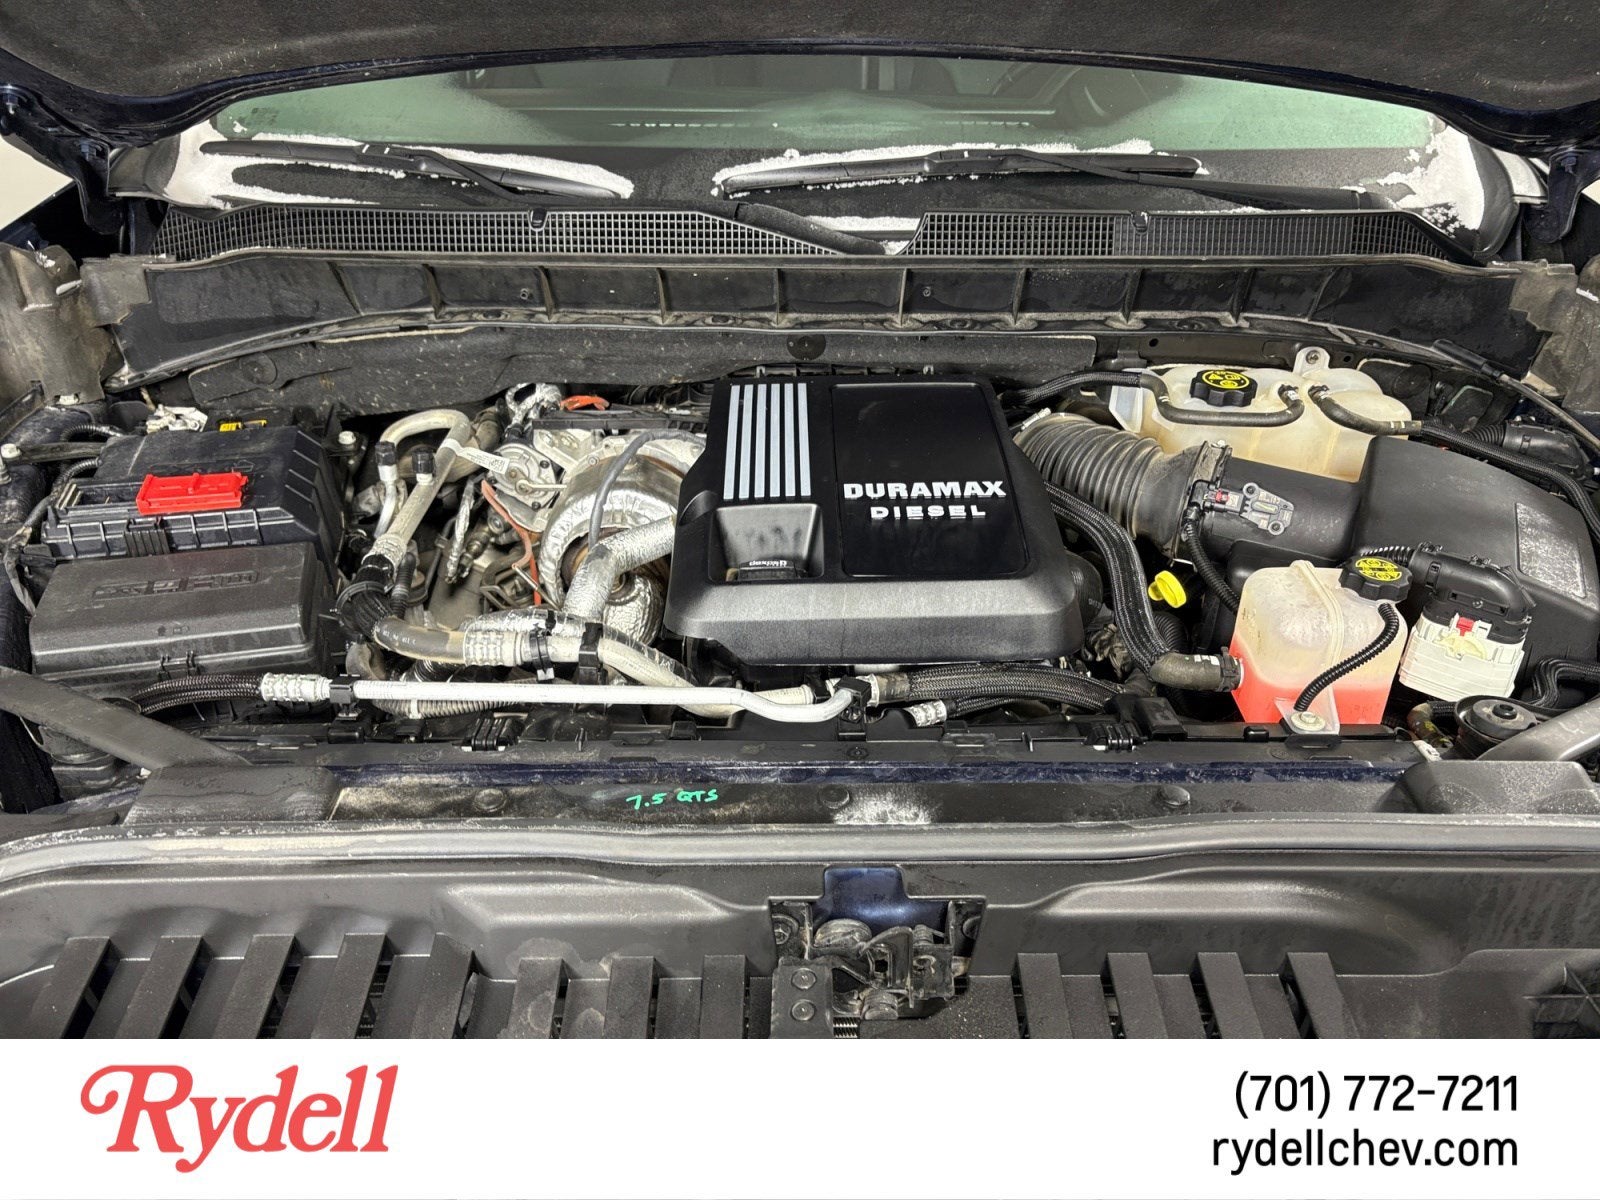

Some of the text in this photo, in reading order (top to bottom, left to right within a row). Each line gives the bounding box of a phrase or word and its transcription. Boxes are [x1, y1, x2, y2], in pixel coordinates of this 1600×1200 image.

[843, 481, 1006, 499] DURAMAX
[870, 505, 986, 519] DIESEL
[626, 788, 718, 810] 7.5 QTS
